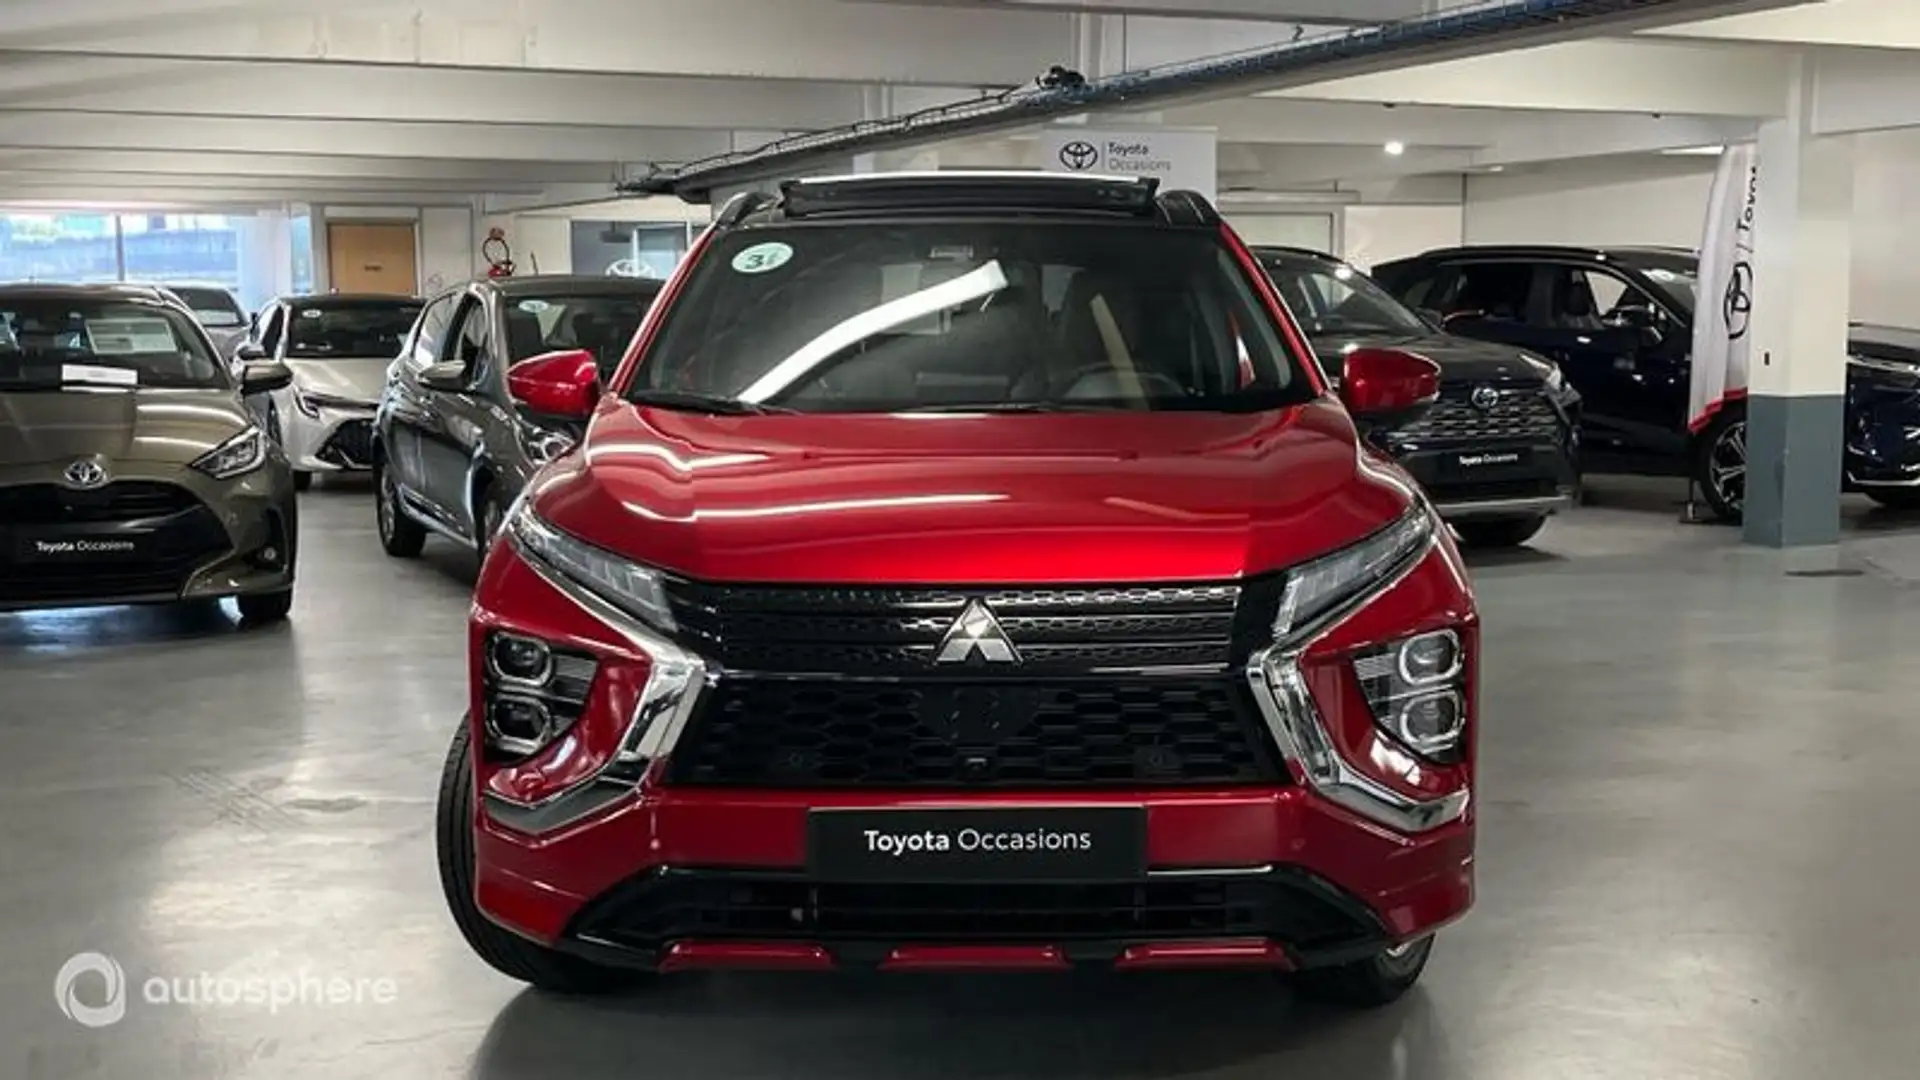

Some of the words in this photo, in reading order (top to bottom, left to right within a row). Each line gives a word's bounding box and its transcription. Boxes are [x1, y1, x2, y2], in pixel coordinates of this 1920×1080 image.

[1108, 141, 1149, 156] Toyota
[1108, 158, 1171, 171] Occasions
[36, 541, 74, 554] Toyota
[863, 830, 949, 855] Toyota
[957, 828, 1091, 850] Occasions
